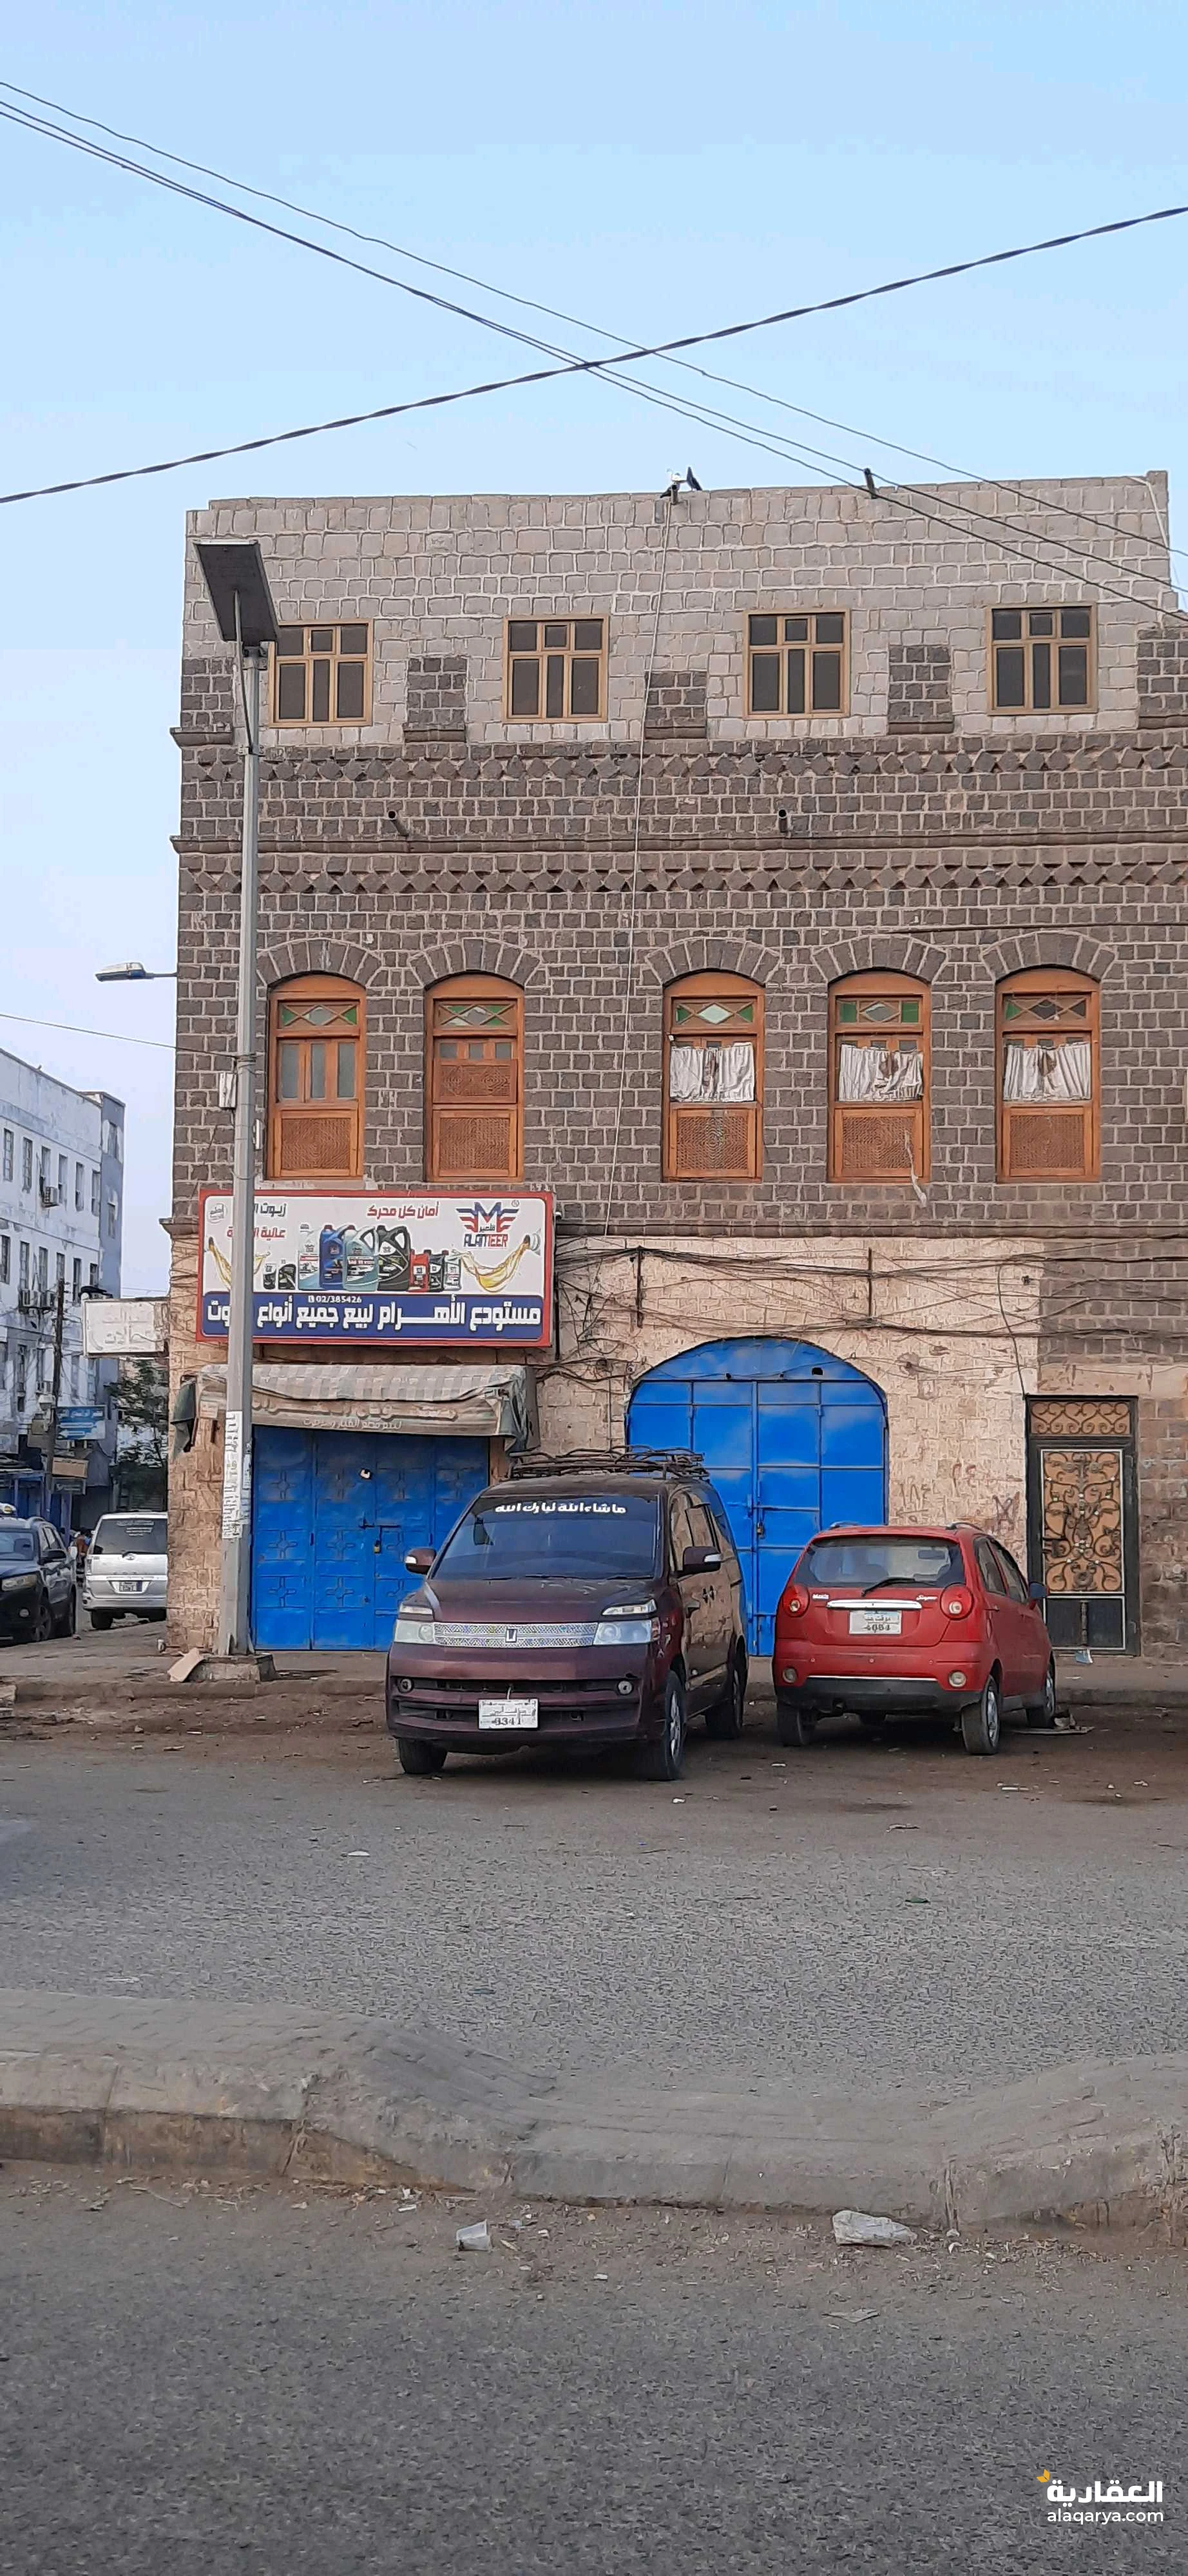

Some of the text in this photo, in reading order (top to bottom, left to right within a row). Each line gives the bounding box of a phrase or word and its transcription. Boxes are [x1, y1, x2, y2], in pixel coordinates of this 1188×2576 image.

[260, 1202, 287, 1217] زيوت
[367, 1202, 439, 1219] أمان كل محرك
[260, 1226, 287, 1241] عالية
[316, 1295, 362, 1303] 02/385426
[258, 1295, 293, 1328] أنواع
[296, 1306, 339, 1329] جميع
[343, 1303, 374, 1329] لبيع
[378, 1294, 466, 1331] الأهرام
[470, 1301, 541, 1331] مستودع
[495, 1502, 521, 1513] الله
[612, 1504, 626, 1513] ما
